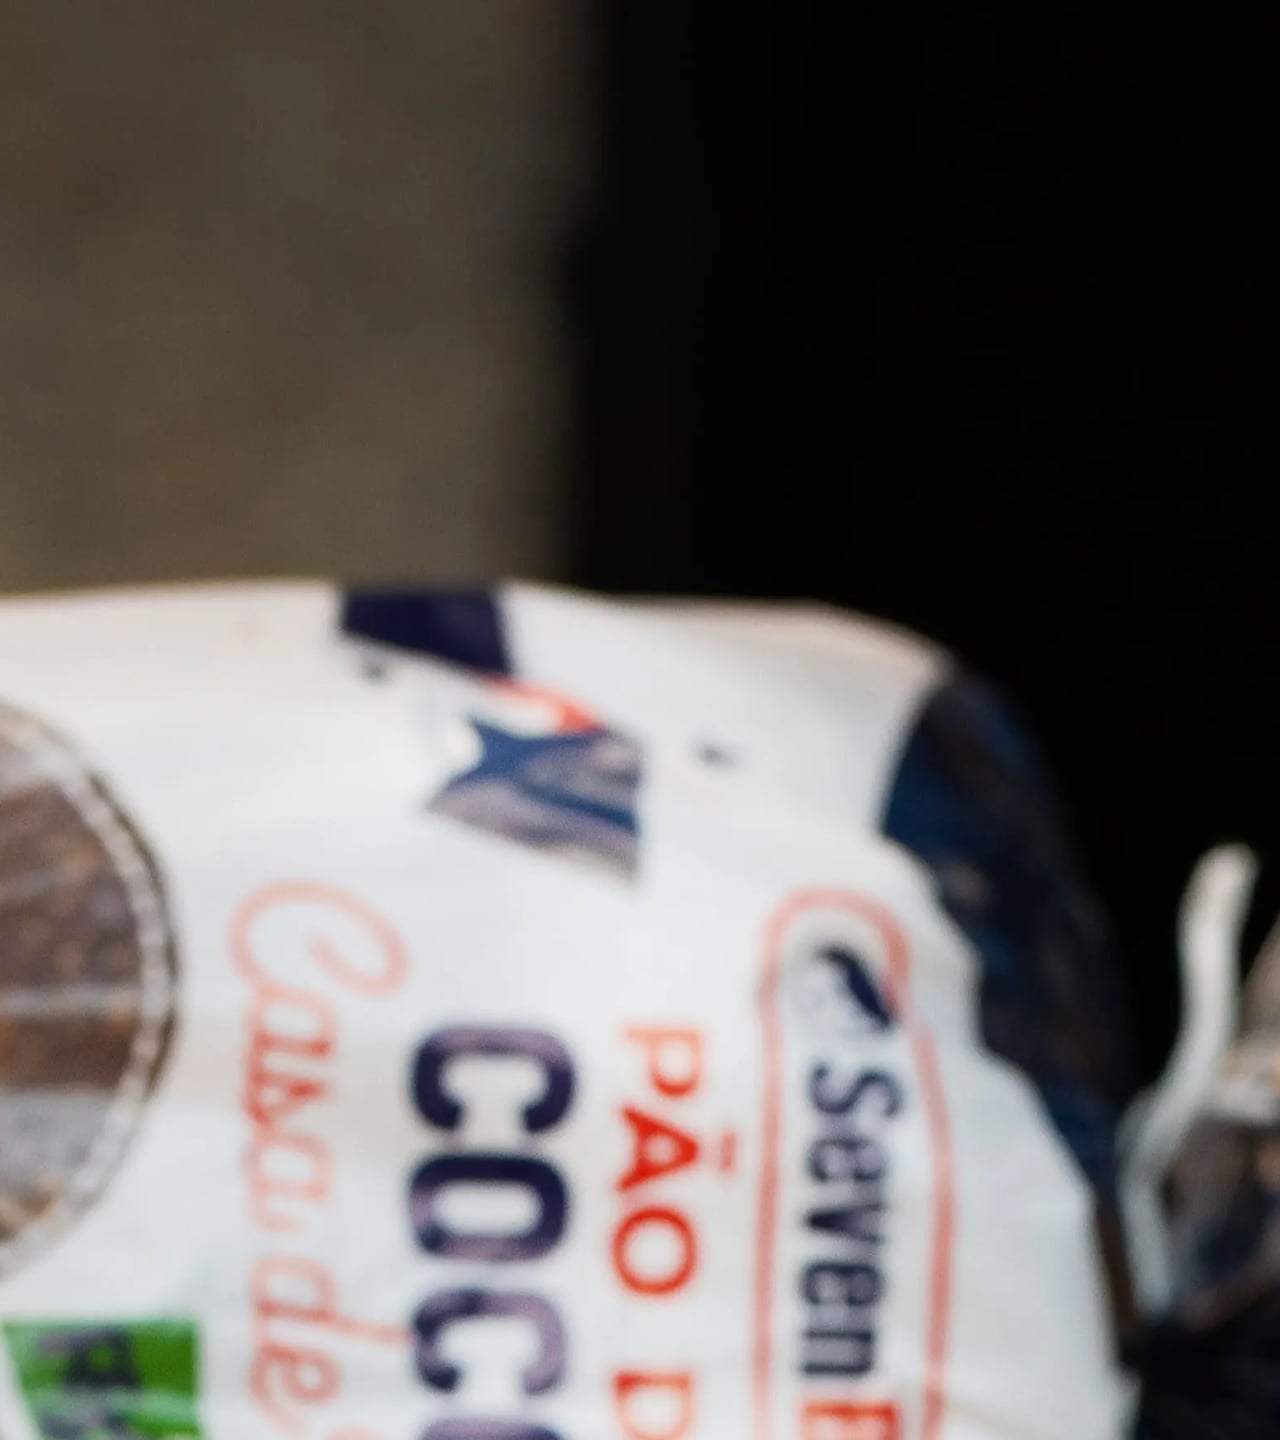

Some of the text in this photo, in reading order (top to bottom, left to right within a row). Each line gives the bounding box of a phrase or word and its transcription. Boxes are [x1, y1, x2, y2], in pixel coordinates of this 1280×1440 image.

[228, 880, 408, 1236] Casa
[610, 1023, 735, 1298] PÃO
[248, 1256, 414, 1440] de
